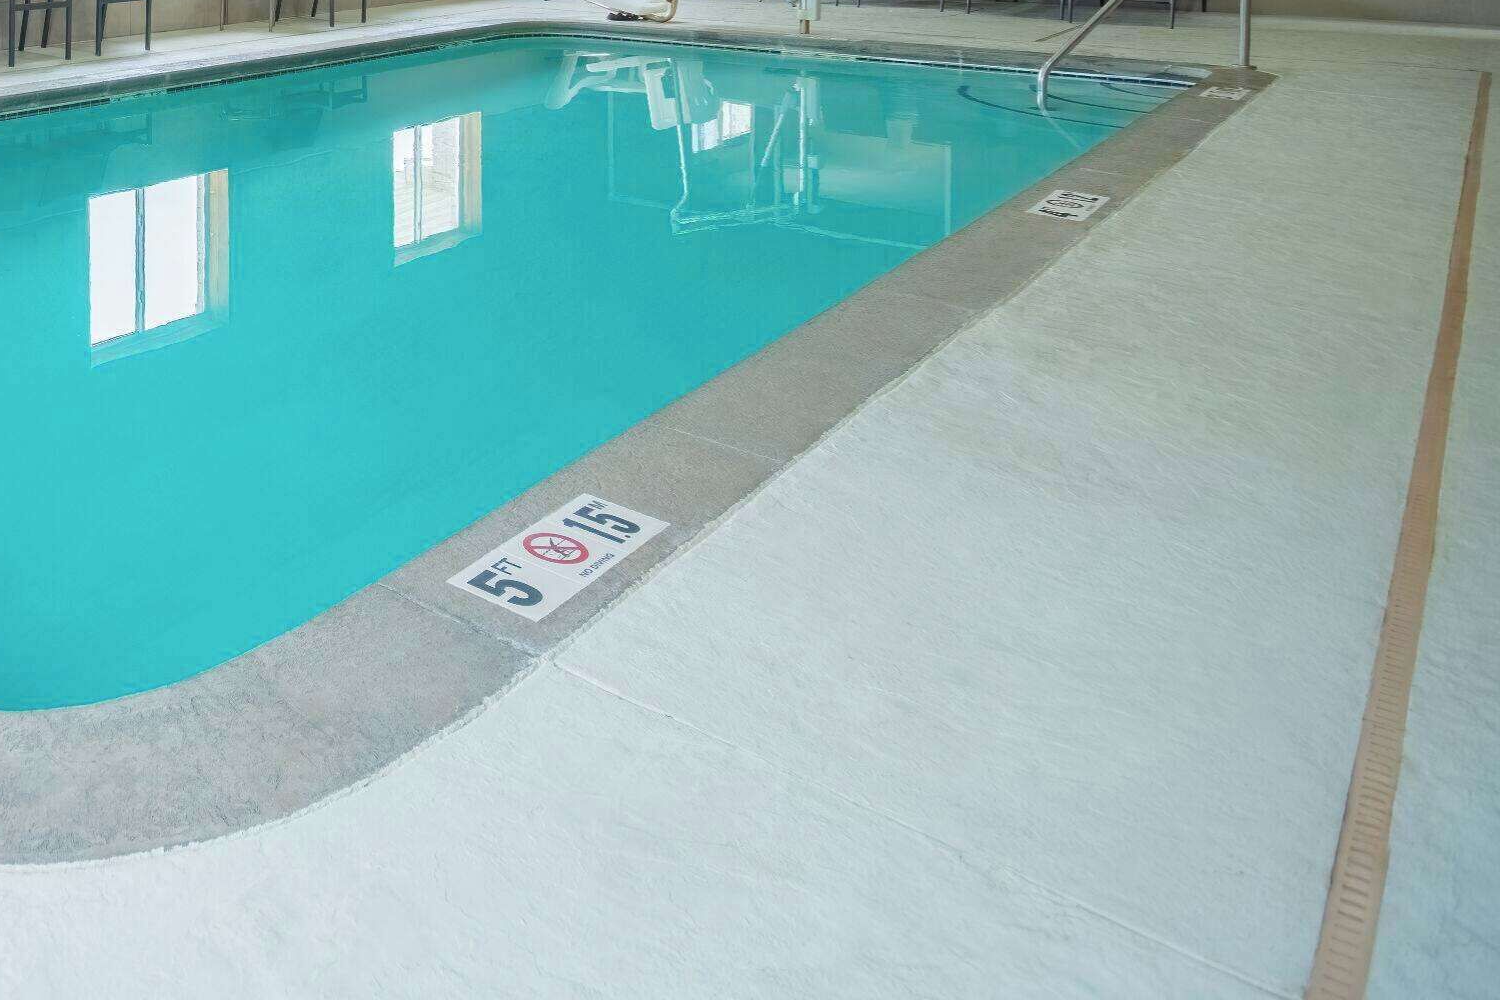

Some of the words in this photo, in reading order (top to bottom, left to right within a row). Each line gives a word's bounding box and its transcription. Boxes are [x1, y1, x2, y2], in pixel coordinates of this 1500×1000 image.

[491, 557, 522, 576] FT
[579, 568, 594, 578] NO
[466, 569, 544, 607] 5
